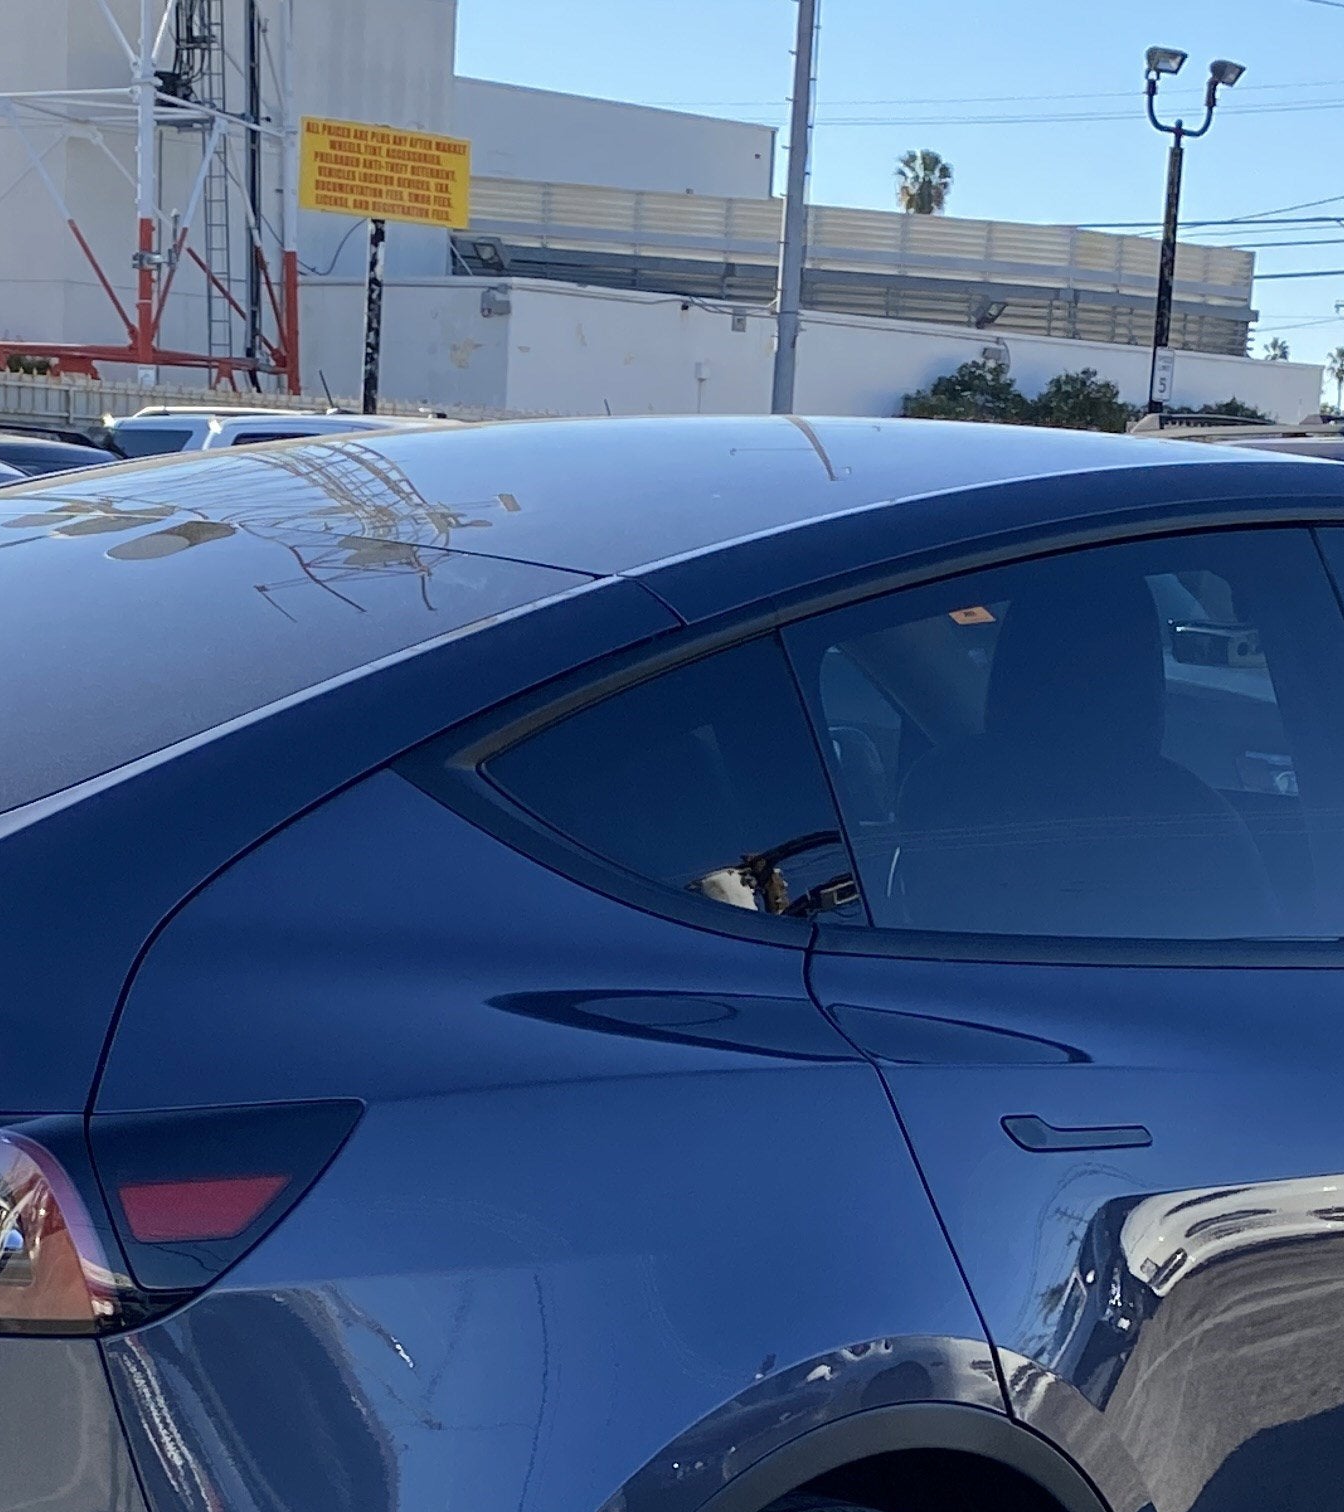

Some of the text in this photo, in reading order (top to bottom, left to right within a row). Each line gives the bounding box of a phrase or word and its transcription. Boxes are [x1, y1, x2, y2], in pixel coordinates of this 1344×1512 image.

[306, 122, 467, 155] ALL PRICES ARE PLUS ANY AFTER MARKET
[362, 158, 409, 173] ANTI-THEFT
[358, 171, 394, 186] LOCATOR
[315, 179, 383, 198] DOCUMENTATION
[353, 198, 369, 210] AND
[371, 201, 429, 218] REGISTRATION
[1158, 377, 1167, 393] 5
